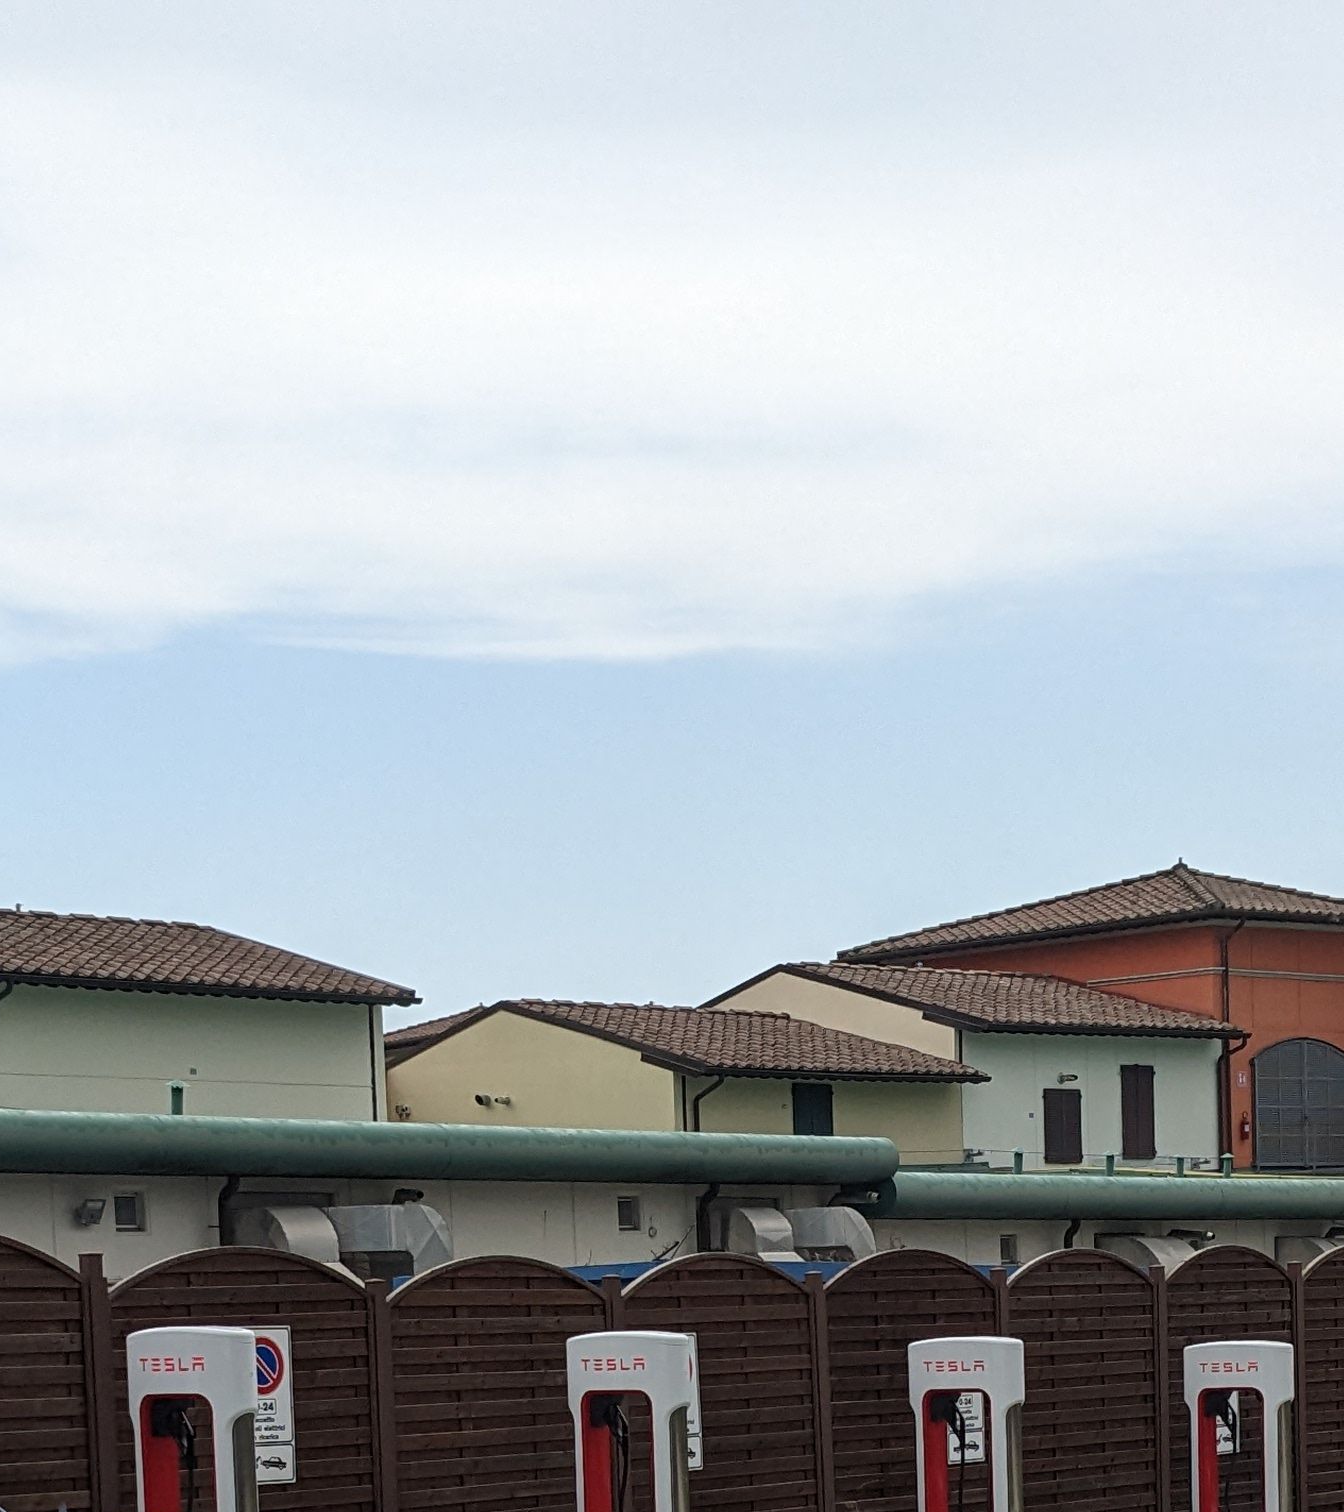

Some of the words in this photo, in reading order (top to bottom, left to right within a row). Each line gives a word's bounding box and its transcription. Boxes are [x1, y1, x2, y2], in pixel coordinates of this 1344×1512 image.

[139, 1356, 205, 1372] TESLA
[580, 1357, 645, 1372] TESLA
[923, 1360, 985, 1373] TESLA
[1199, 1361, 1259, 1373] TESLA
